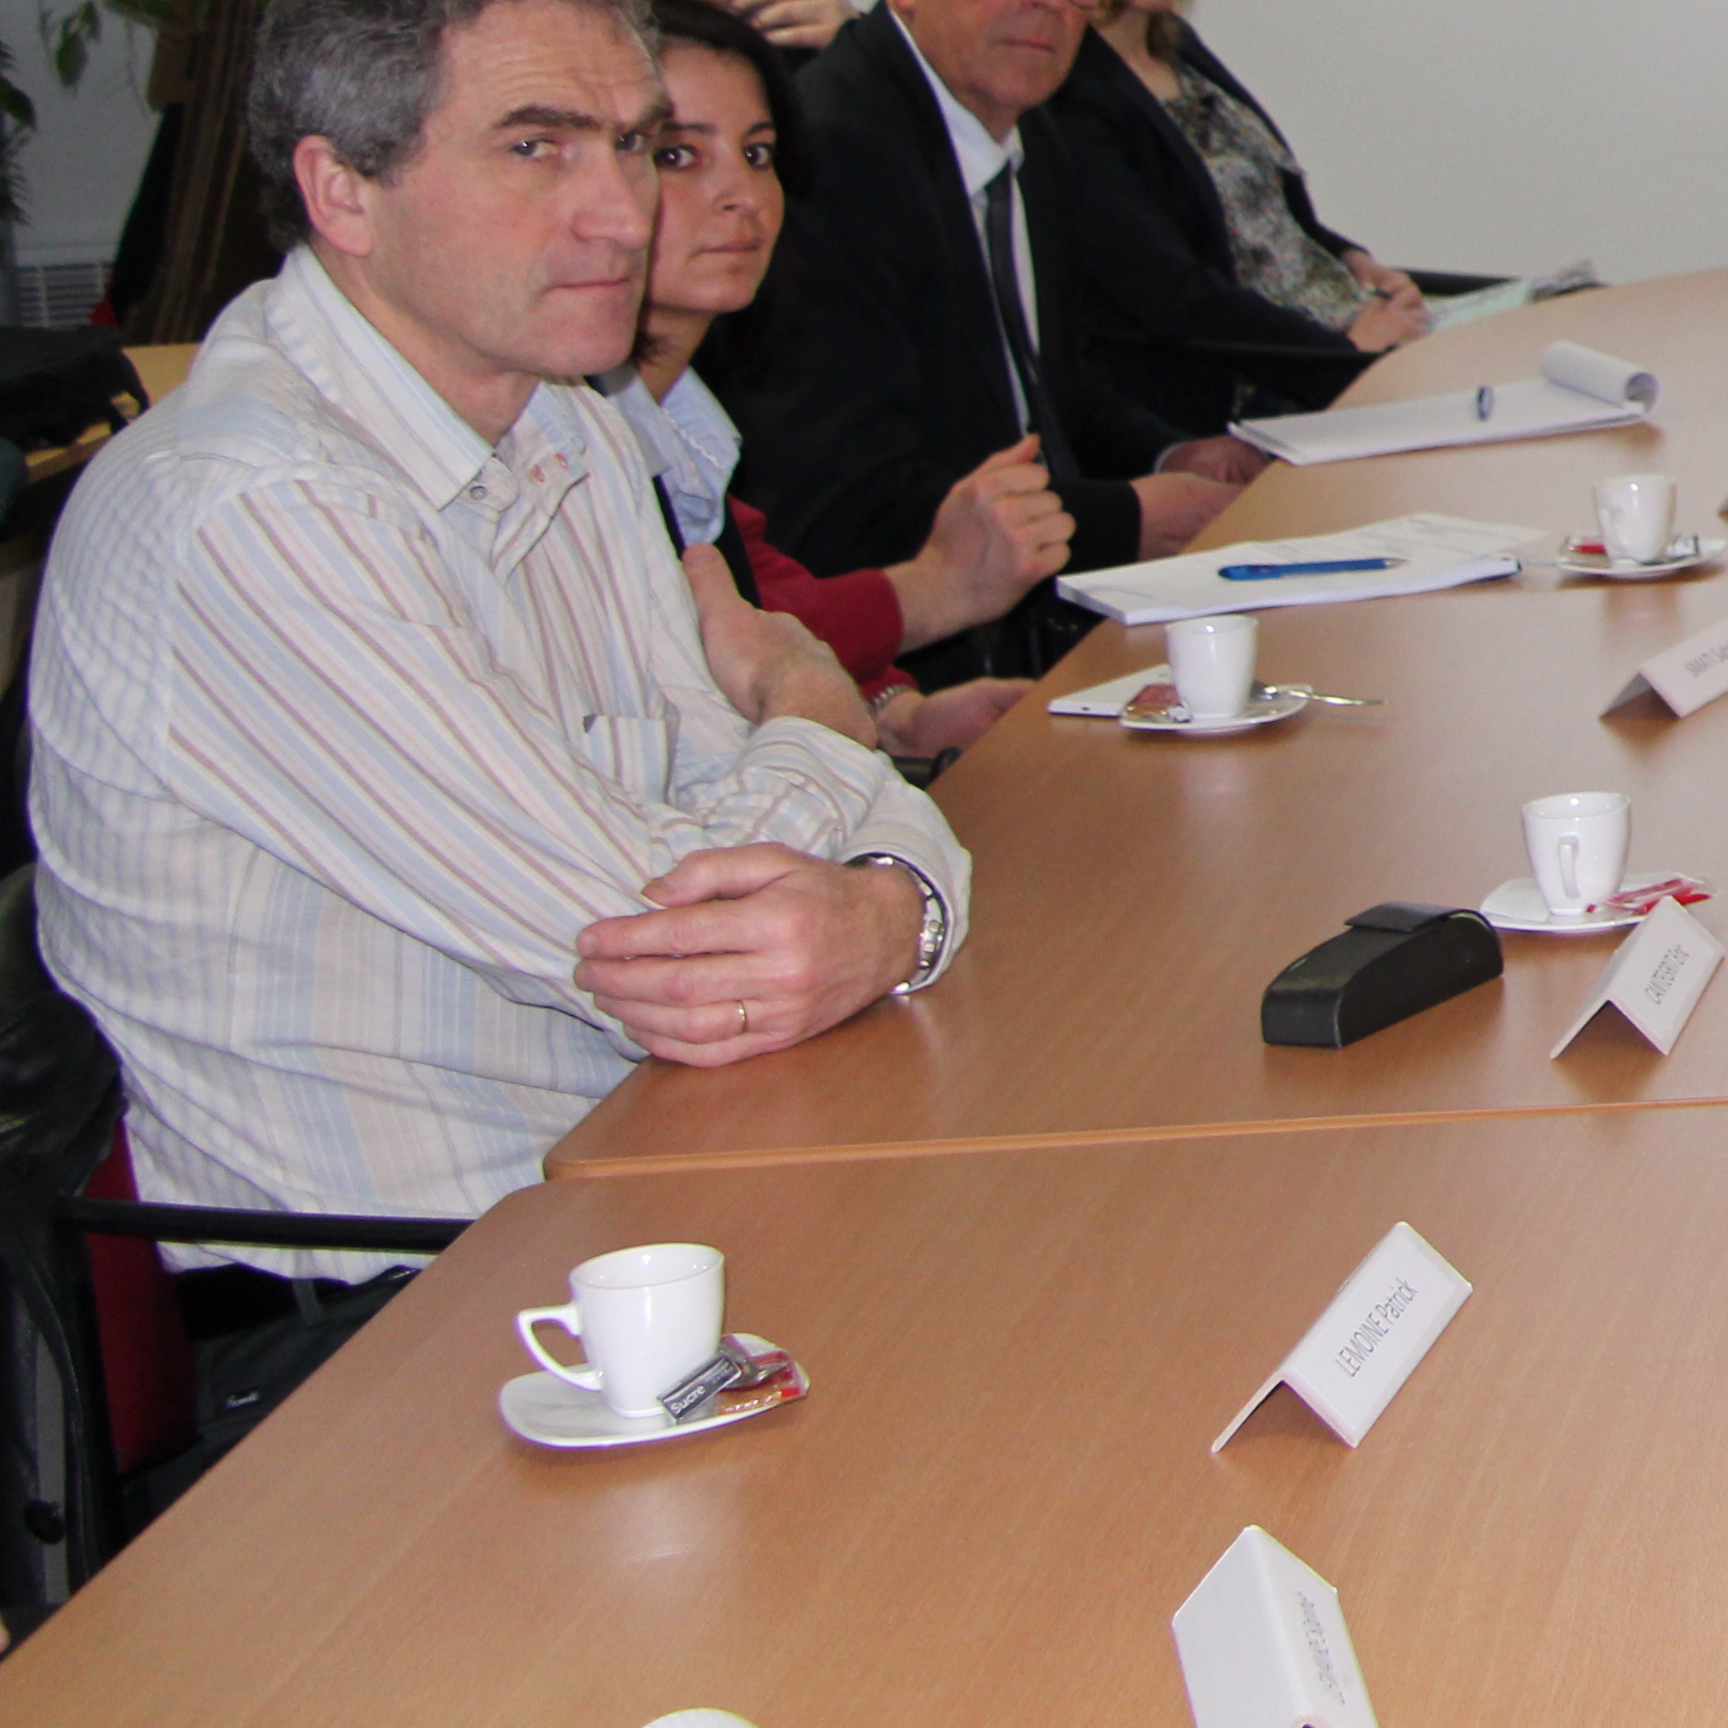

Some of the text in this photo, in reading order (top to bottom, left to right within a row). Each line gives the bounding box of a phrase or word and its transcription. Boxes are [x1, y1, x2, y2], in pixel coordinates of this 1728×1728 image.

[1333, 1276, 1420, 1378] LEMOINE Patrick
[670, 1384, 707, 1416] Sucre
